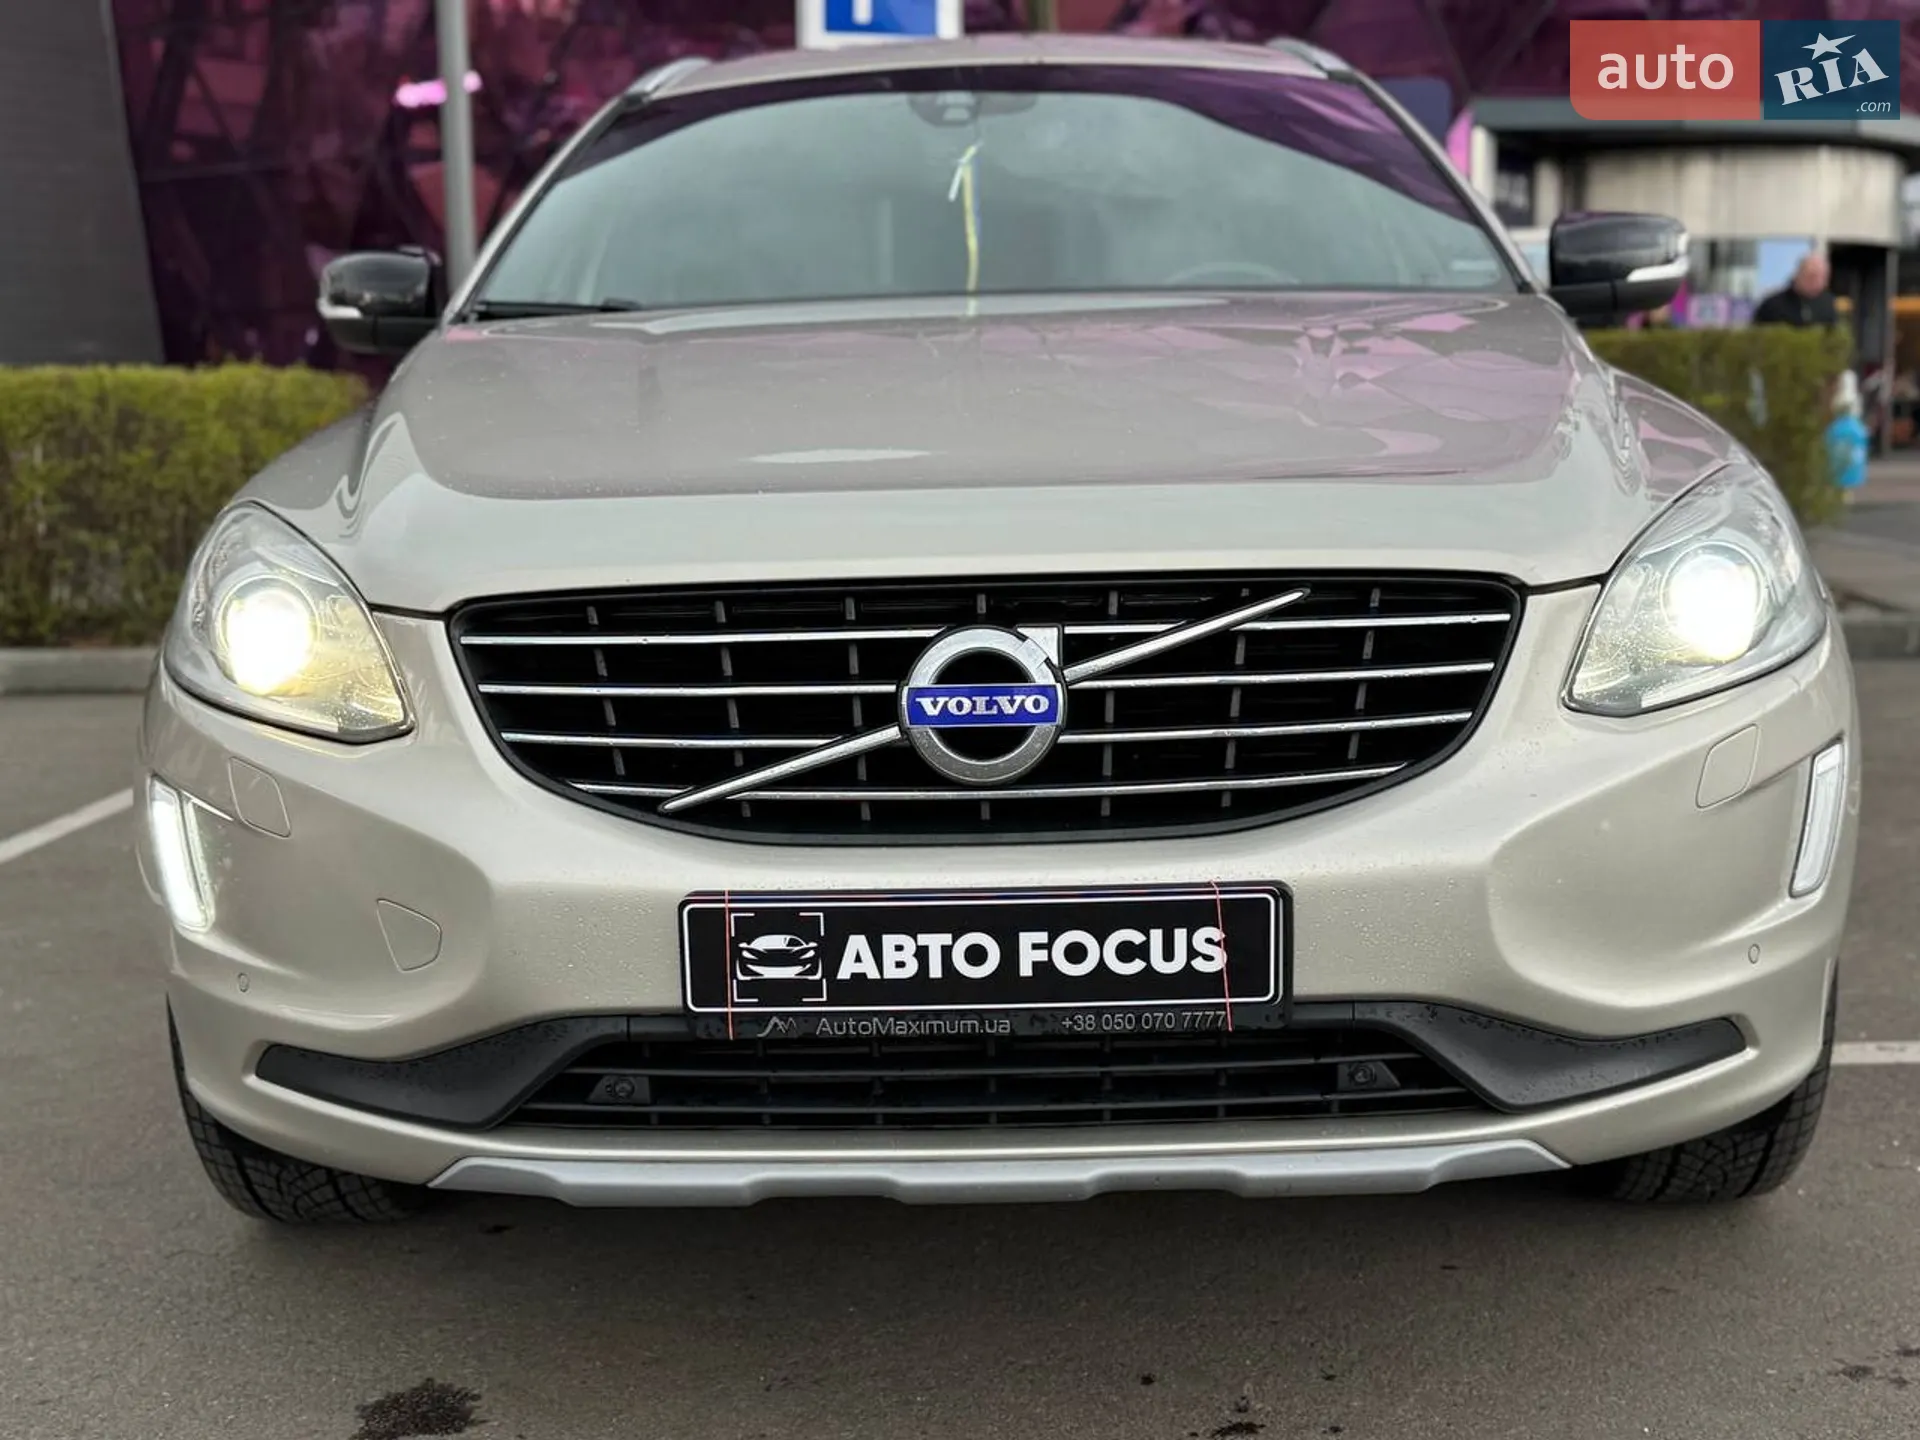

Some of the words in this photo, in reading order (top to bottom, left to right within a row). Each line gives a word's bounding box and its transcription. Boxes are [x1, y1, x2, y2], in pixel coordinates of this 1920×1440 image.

[915, 694, 1050, 717] VOLVO
[836, 931, 1001, 980] АВТО
[1018, 926, 1228, 977] FOCUS
[815, 1016, 1012, 1036] AutoMaximum.ua
[1061, 1013, 1096, 1032] +38
[1101, 1012, 1137, 1031] 050
[1141, 1012, 1176, 1030] 070
[1182, 1010, 1226, 1029] 7777
